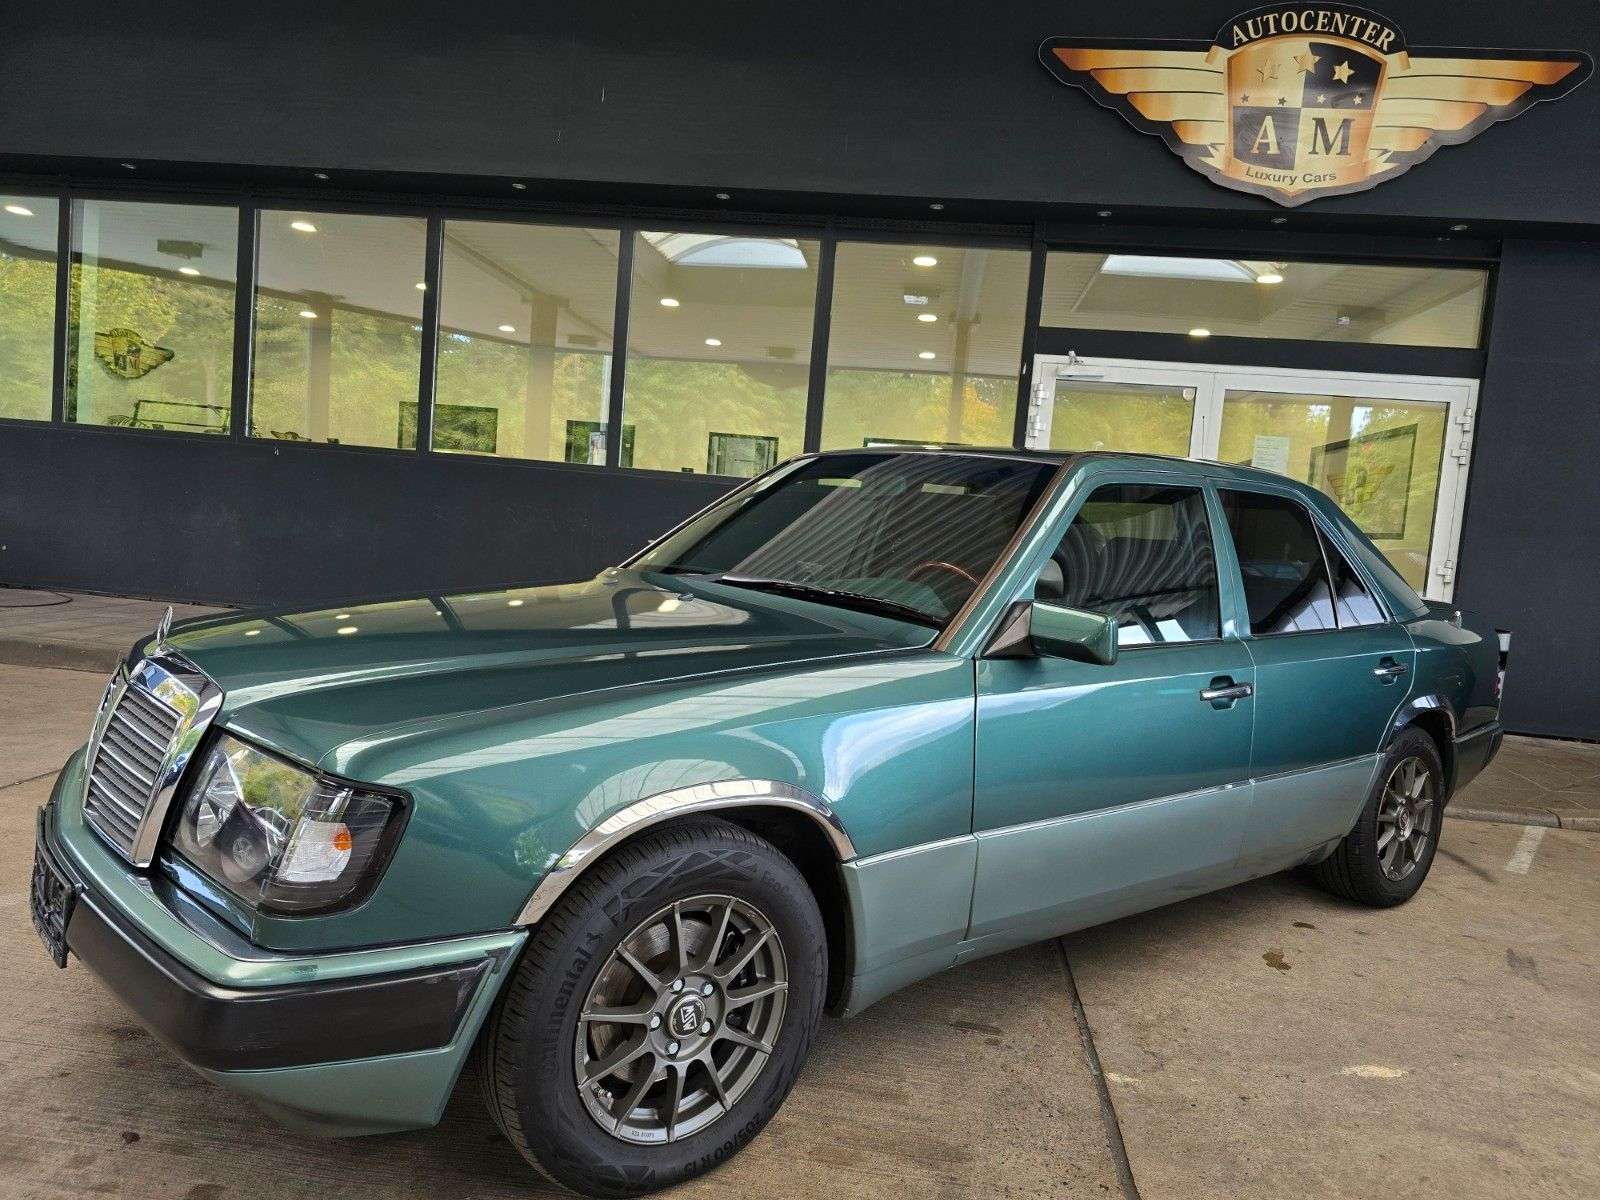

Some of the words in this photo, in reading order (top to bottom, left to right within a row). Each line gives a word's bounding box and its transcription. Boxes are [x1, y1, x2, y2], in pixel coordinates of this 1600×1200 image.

[1232, 10, 1395, 51] AUTOCENTER
[1250, 115, 1281, 155] A
[1308, 117, 1356, 156] M
[1245, 167, 1298, 186] Luxury
[1302, 172, 1337, 184] Cars
